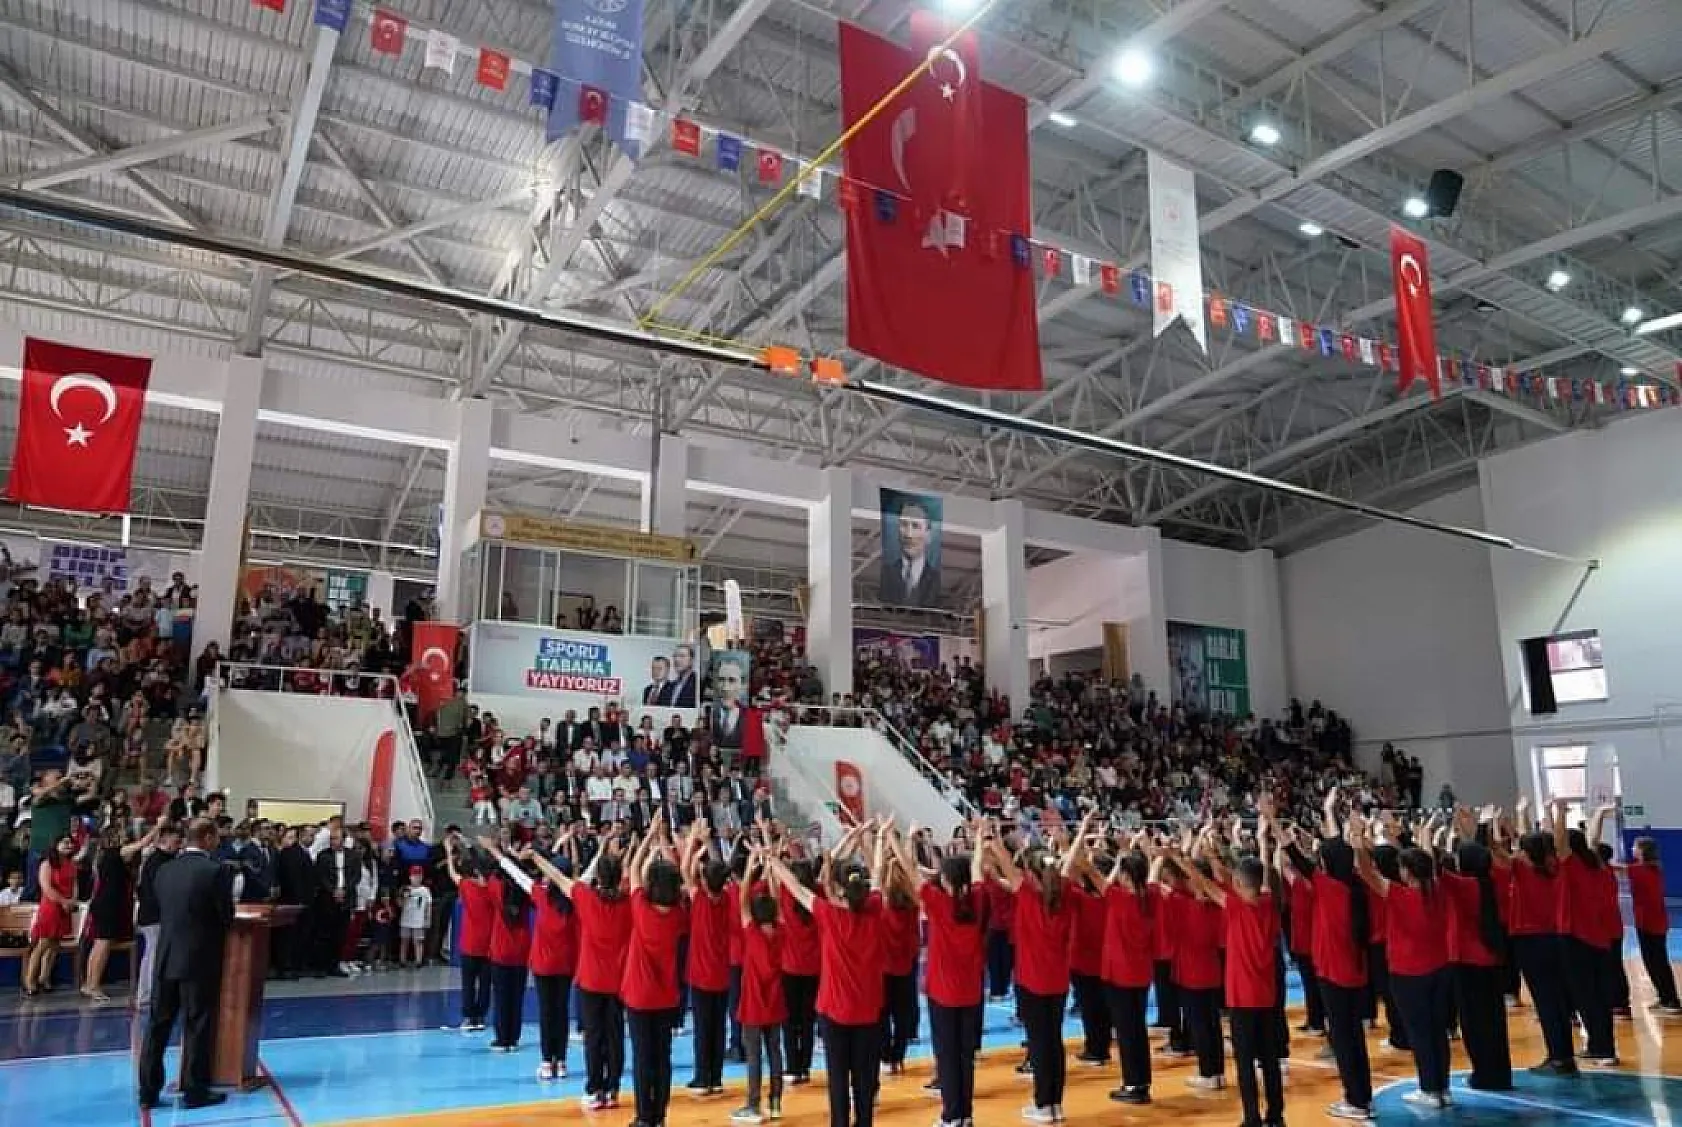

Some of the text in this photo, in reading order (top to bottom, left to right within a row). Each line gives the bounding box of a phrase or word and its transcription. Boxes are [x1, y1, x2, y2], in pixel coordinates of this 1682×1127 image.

[545, 640, 599, 658] SPORU
[538, 658, 605, 674] TABANA
[531, 671, 617, 692] YAYIYORUZ
